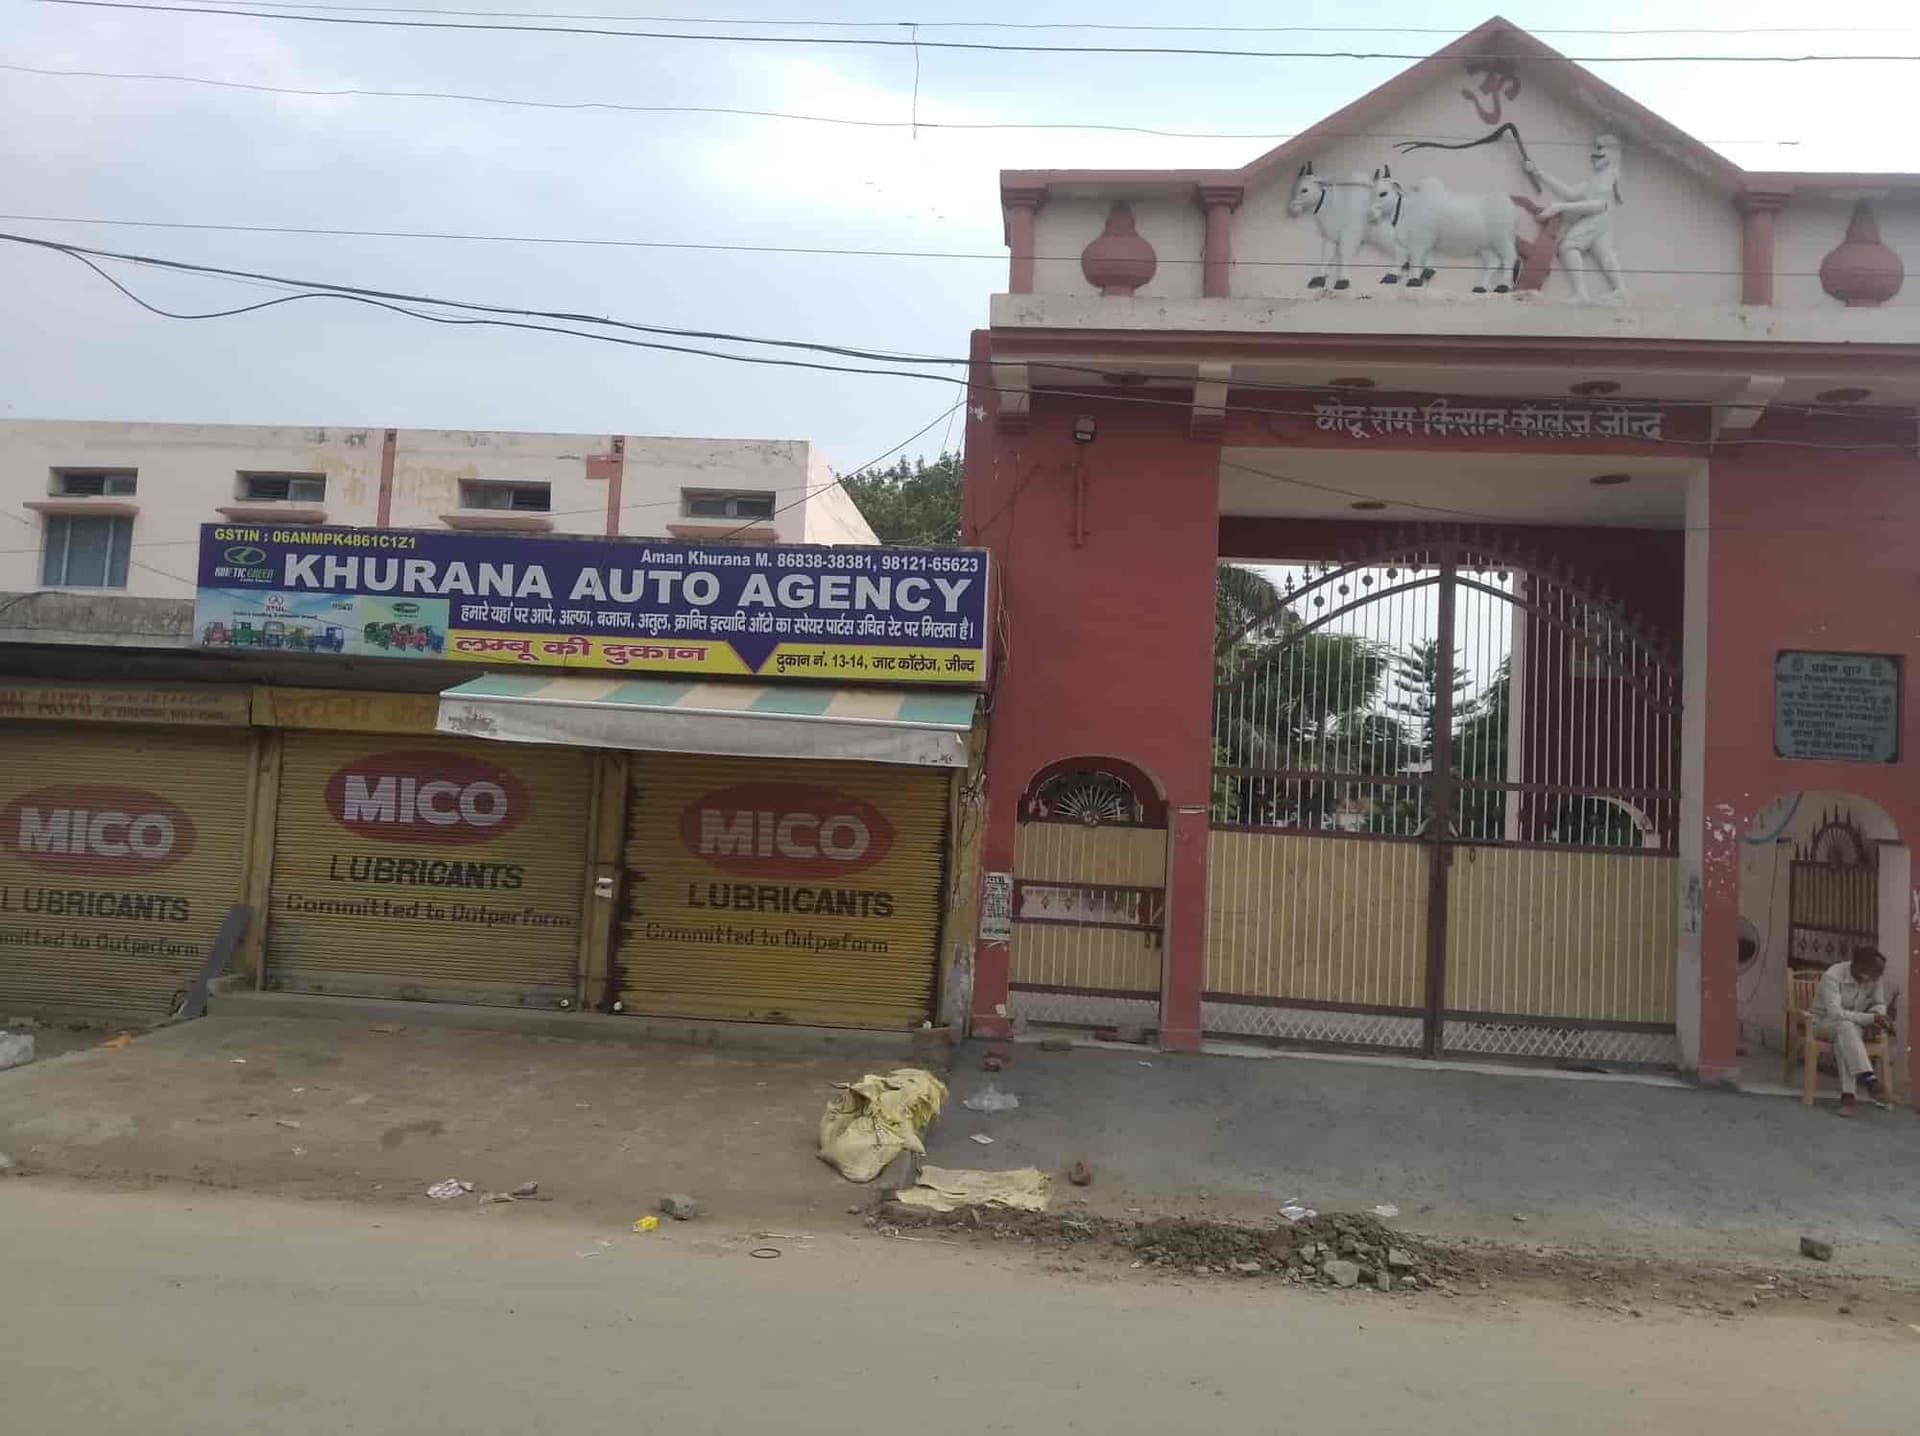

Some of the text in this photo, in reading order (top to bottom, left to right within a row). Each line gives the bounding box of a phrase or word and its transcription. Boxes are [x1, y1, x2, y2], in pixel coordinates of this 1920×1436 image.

[1369, 405, 1416, 436] राम
[1420, 400, 1507, 437] किसान
[214, 528, 259, 542] GSTIN
[272, 531, 416, 549] 06ANMPK4861C1Z1
[640, 549, 978, 573] Aman Khurana M. 86838-38381, 98121-65623
[283, 553, 973, 613] KHURANA AUTO AGENCY
[460, 602, 489, 622] हमारे
[490, 602, 511, 624] यहां
[513, 606, 529, 624] पर
[530, 604, 556, 625] आपे,
[560, 608, 594, 628] अल्फा,
[597, 609, 635, 629] बजाज,
[638, 612, 671, 636] अतुल,
[674, 608, 708, 632] क्रान्ति
[709, 611, 747, 634] इत्यादि
[748, 612, 773, 633] ऑटो
[775, 615, 791, 634] का
[793, 613, 823, 636] स्पेयर
[856, 613, 884, 637] उचित
[886, 615, 904, 638] रेट
[904, 620, 920, 639] पर
[921, 615, 957, 640] मिलता
[455, 634, 708, 666] लम्बू की दुकान
[776, 650, 975, 674] दुकान नं. 13-14, जाट कॉलेज, जीन्द
[343, 775, 508, 827] MICO
[19, 807, 175, 858] MICO
[699, 808, 871, 861] MICO
[329, 855, 525, 889] LUBRICANTS
[1, 886, 192, 921] LUBRICANTS
[285, 893, 419, 918] Committed
[426, 902, 446, 918] to
[688, 881, 894, 919] LUBRICANTS
[71, 931, 91, 947] to
[95, 932, 202, 956] Outperform
[645, 921, 755, 946] Committed
[761, 926, 781, 945] to
